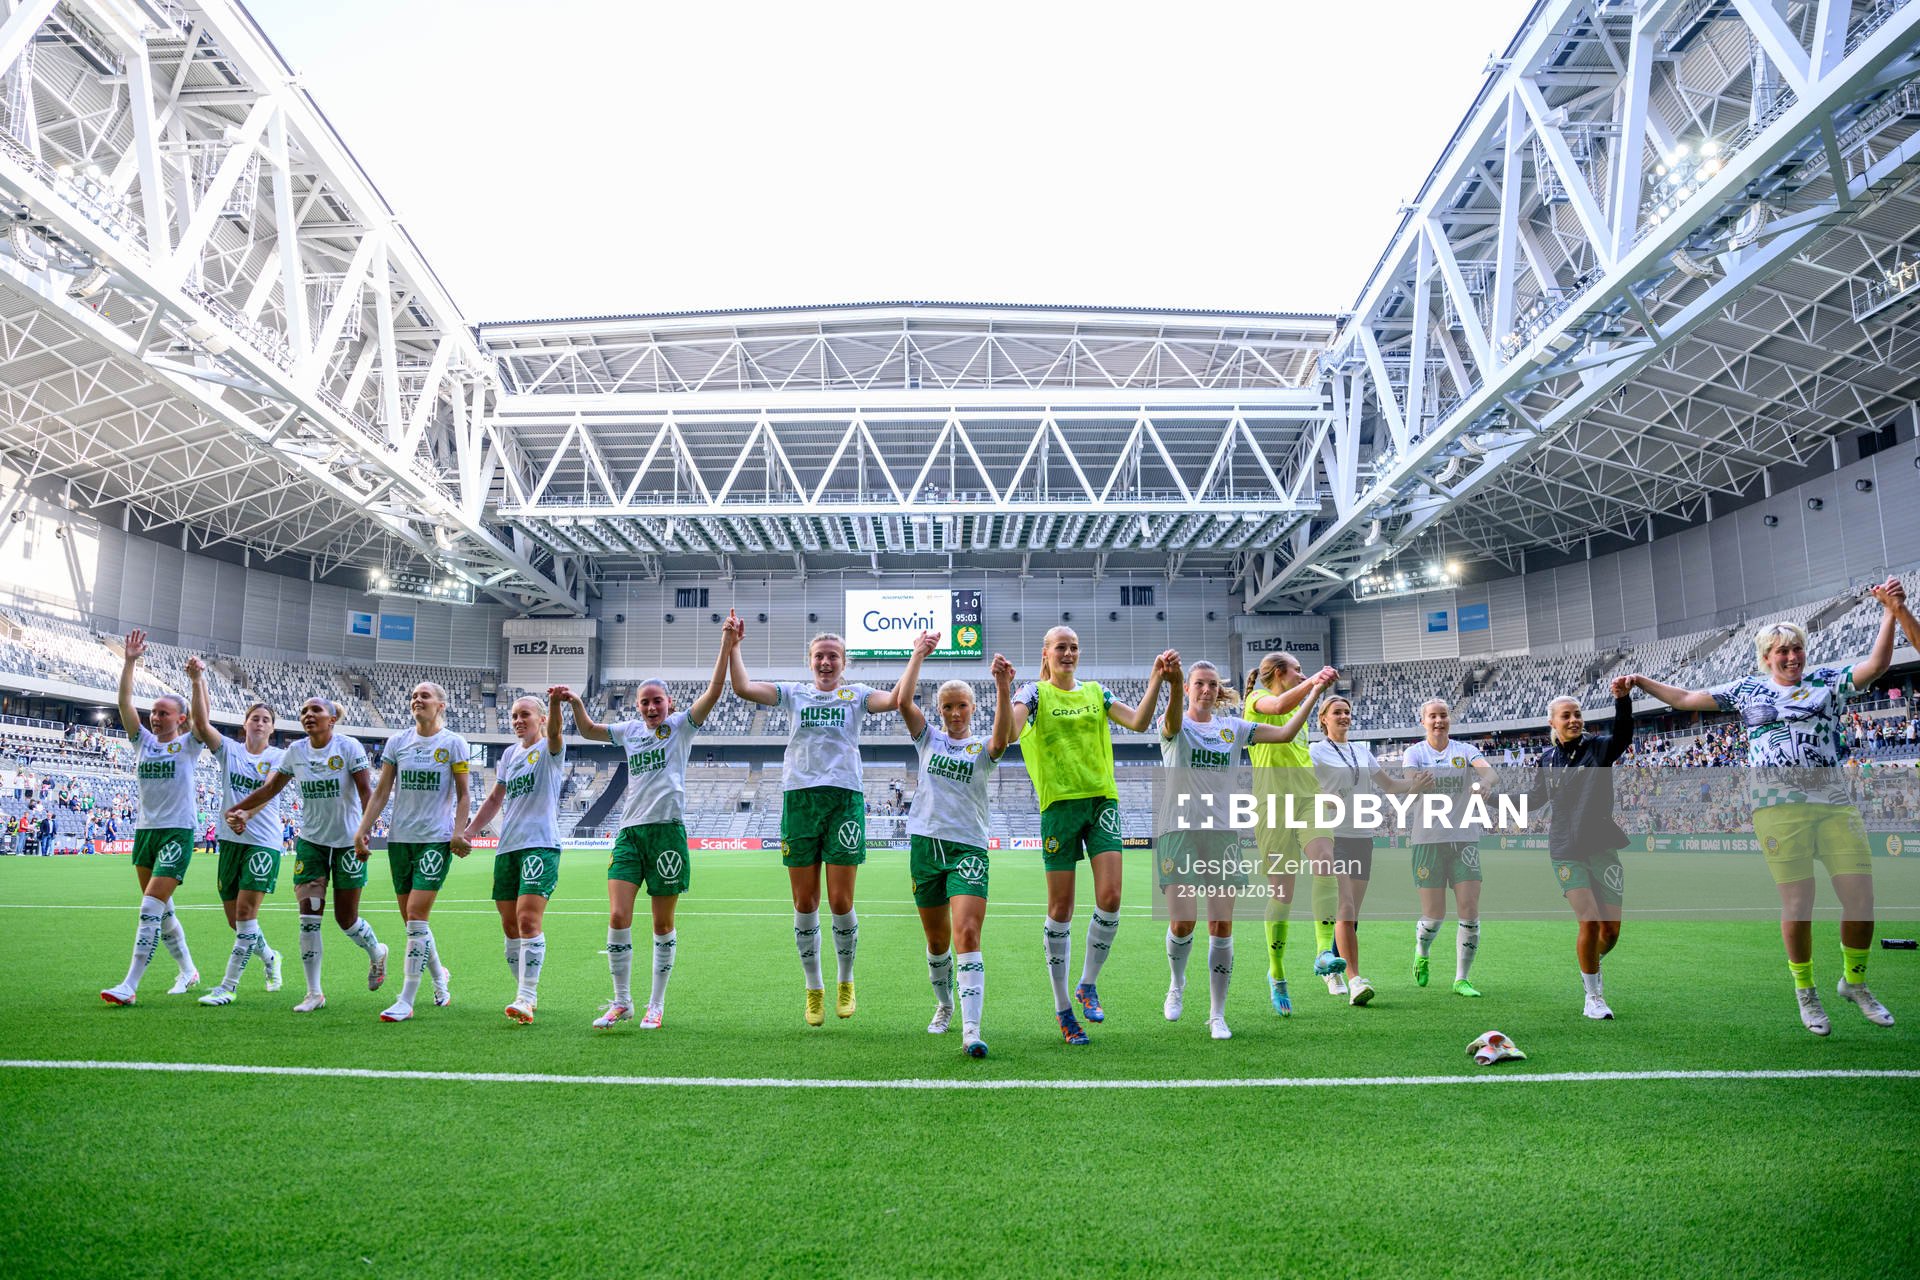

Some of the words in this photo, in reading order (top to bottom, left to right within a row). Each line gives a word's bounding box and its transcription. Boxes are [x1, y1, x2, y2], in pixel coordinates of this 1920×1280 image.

[955, 598, 960, 608] 1
[971, 598, 978, 608] 0
[863, 610, 934, 632] Convini
[955, 613, 977, 622] 95:03
[513, 641, 548, 655] TELE2
[550, 644, 584, 655] Arena
[1246, 637, 1282, 651] TELE2
[1285, 641, 1320, 651] Arena
[801, 707, 845, 720] HUSKI
[1052, 706, 1090, 716] CRAFT
[801, 720, 846, 728] CHOCOLATE
[629, 748, 666, 769] HUSKI
[929, 753, 974, 776] HUSKI
[138, 760, 176, 773] HUSKI
[401, 770, 441, 785] HUSKI
[927, 766, 972, 784] CHOCOLATE
[1435, 776, 1464, 788] USKI
[301, 779, 340, 793] HUSKI
[401, 783, 441, 791] CHOCOLATE
[507, 772, 535, 794] HUSKI
[700, 838, 748, 849] Scandic
[1686, 836, 1700, 850] FÖR
[1732, 840, 1748, 851] SES
